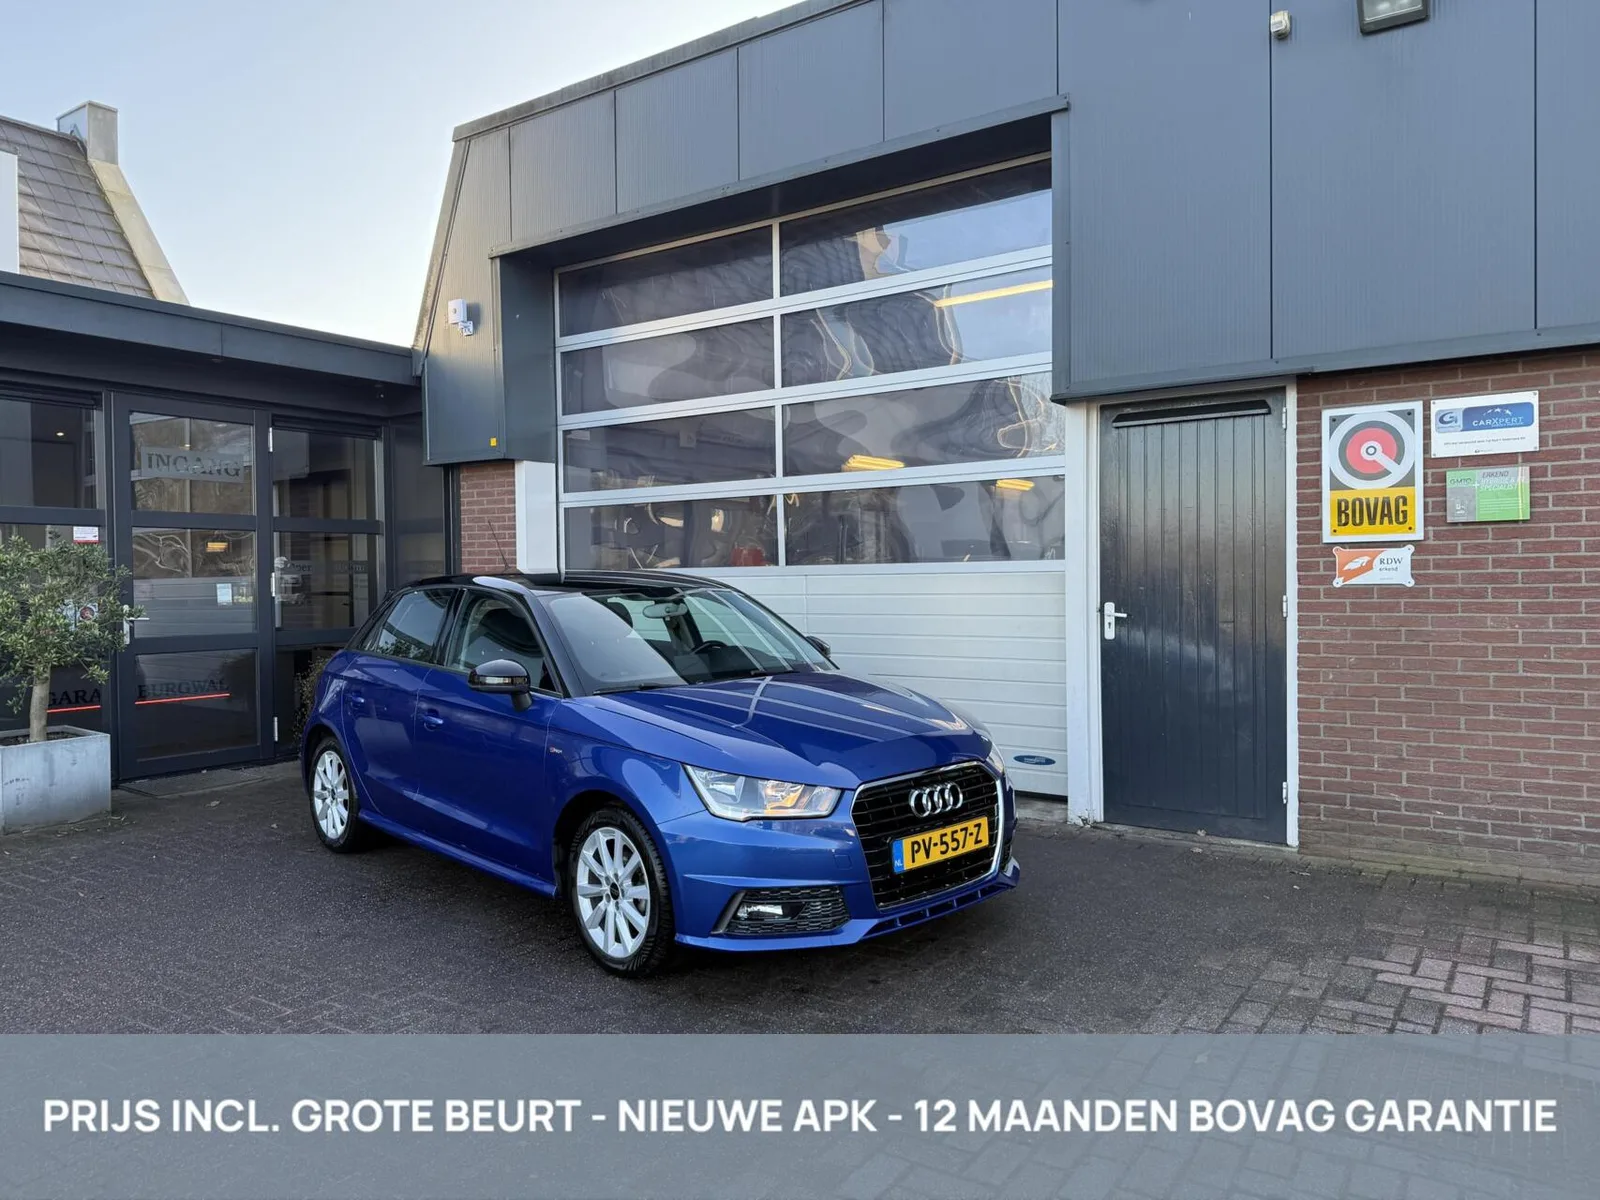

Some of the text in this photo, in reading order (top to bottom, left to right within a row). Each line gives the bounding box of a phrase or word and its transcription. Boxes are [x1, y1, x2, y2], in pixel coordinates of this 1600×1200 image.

[146, 453, 240, 477] INGANG
[1337, 496, 1408, 527] BOVAG
[1379, 557, 1403, 565] RDW
[910, 822, 983, 864] PV-557-Z
